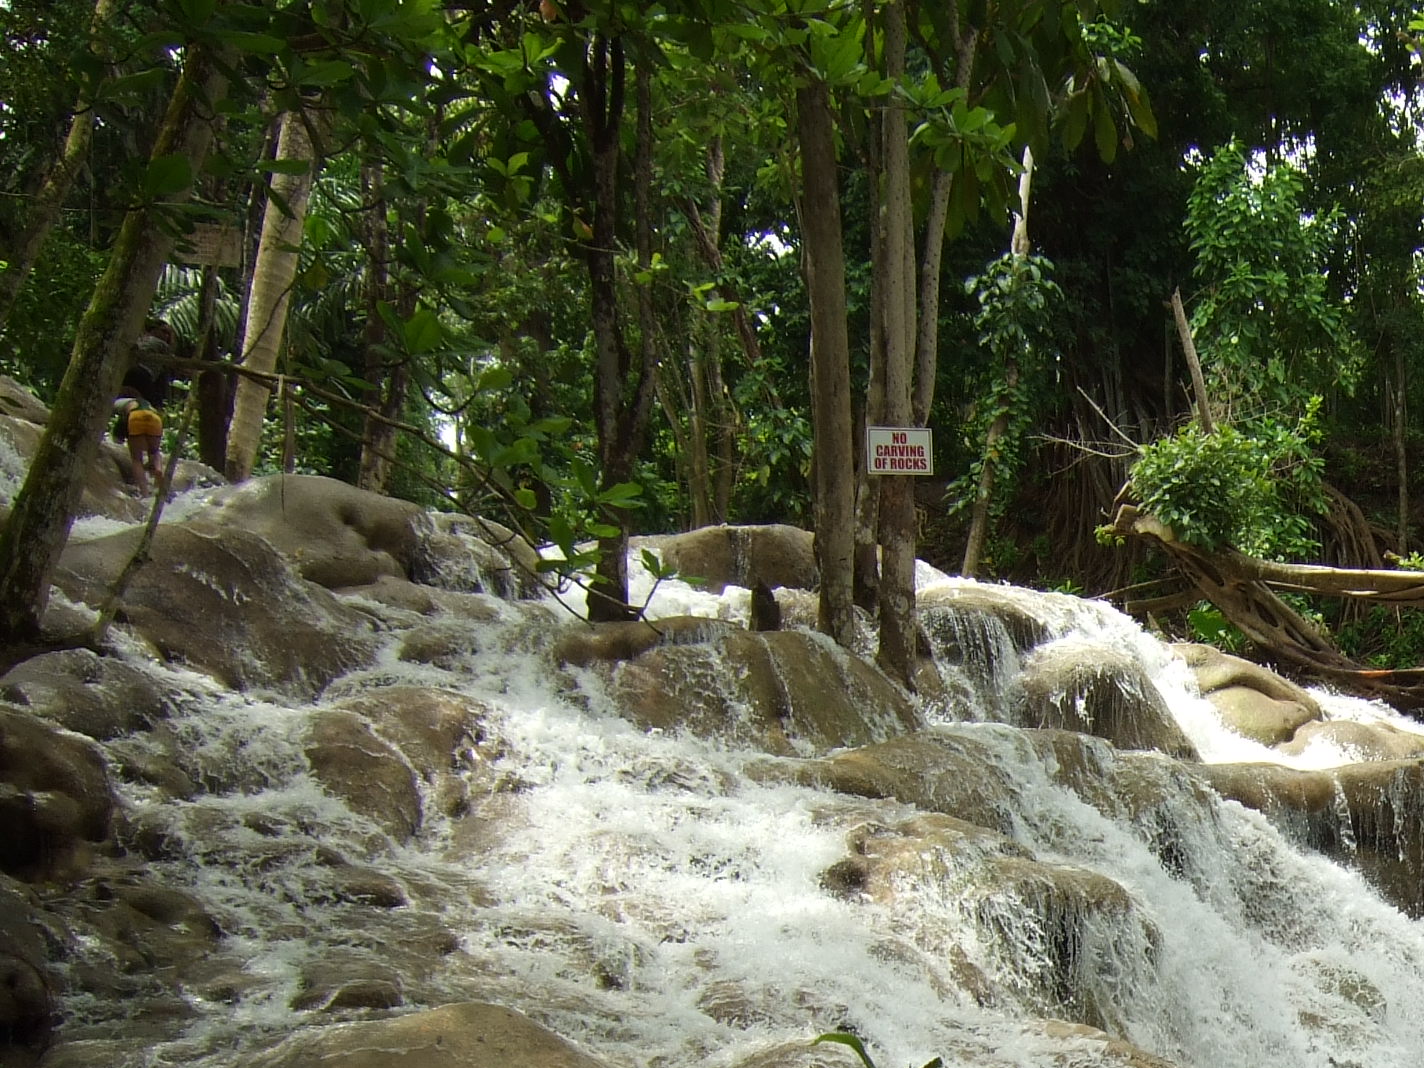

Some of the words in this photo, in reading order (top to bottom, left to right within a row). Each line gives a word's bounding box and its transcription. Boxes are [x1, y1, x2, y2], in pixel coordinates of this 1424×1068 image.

[892, 432, 907, 444] NO
[876, 445, 925, 457] CARVING
[875, 458, 887, 470] OF
[890, 458, 927, 470] ROCKS
